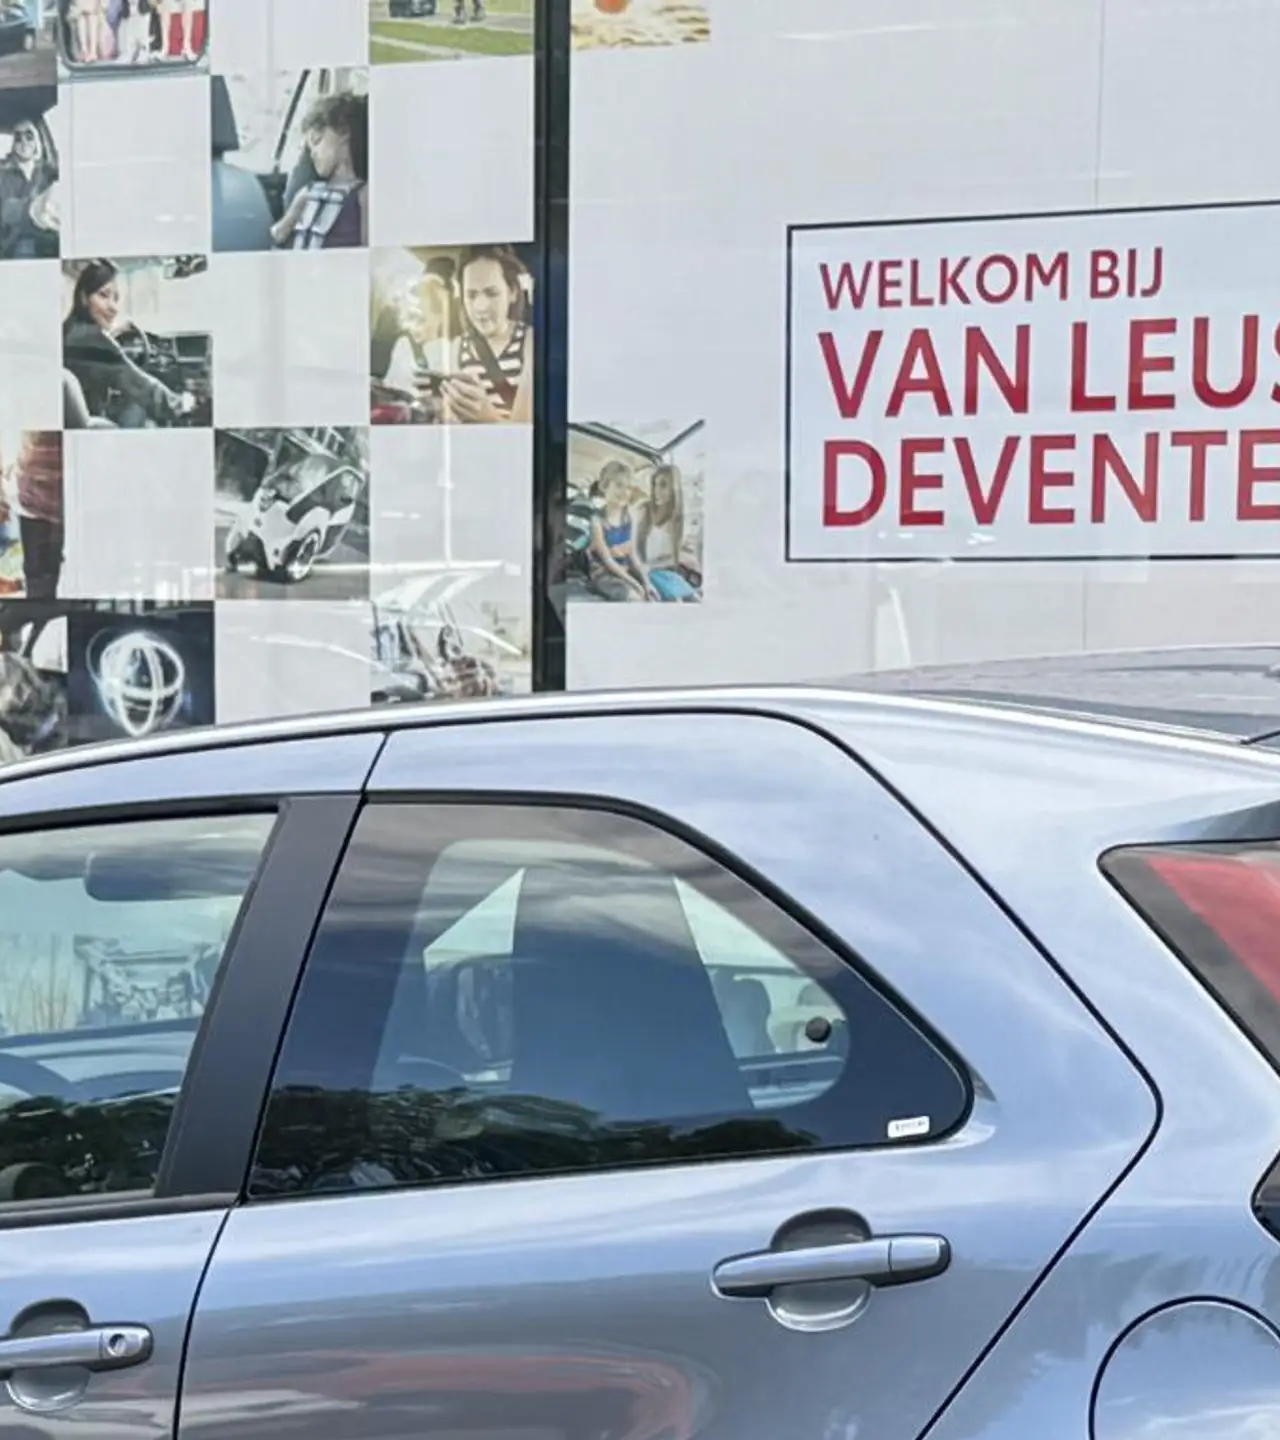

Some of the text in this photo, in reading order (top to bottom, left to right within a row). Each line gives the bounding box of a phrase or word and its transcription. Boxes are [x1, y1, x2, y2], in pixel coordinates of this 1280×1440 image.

[819, 246, 1164, 311] WELKOM BIJ
[818, 323, 1032, 419] VAN
